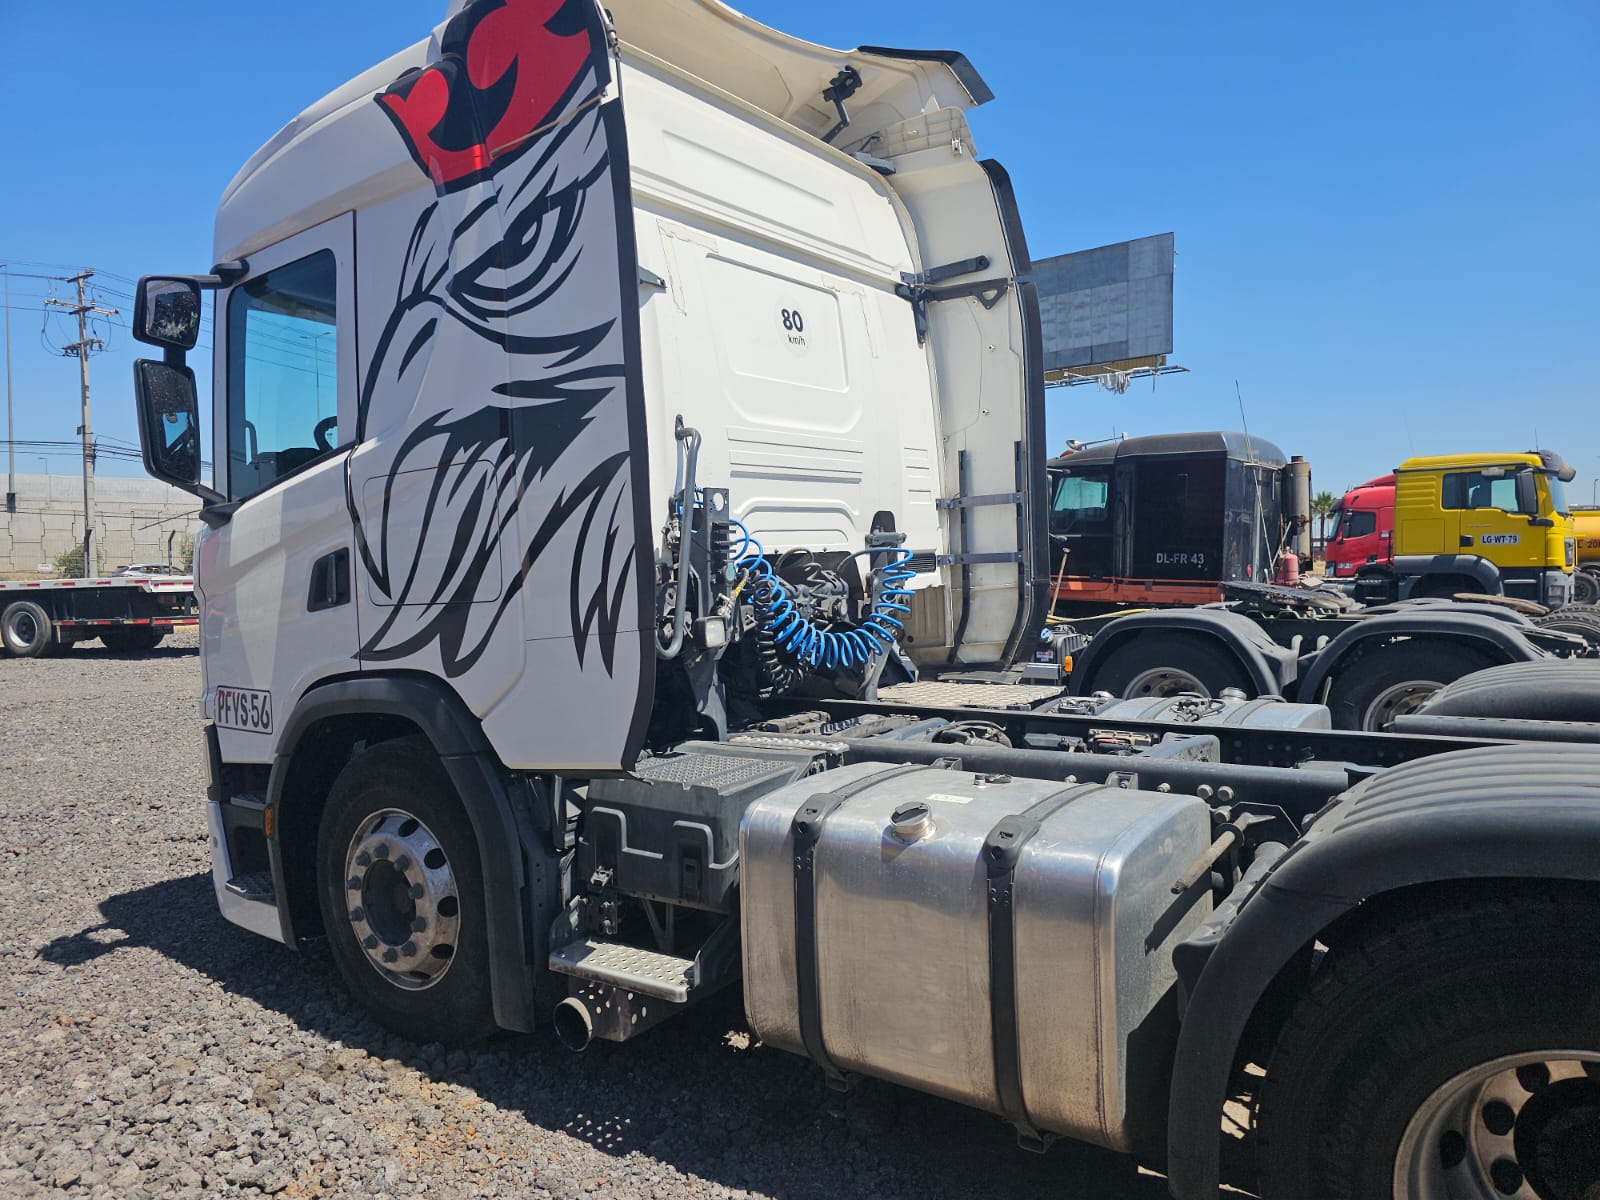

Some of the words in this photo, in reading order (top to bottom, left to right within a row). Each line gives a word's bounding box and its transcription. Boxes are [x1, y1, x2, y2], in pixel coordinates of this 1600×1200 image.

[781, 308, 803, 332] 80
[787, 334, 806, 346] km/h
[1190, 553, 1205, 564] 43
